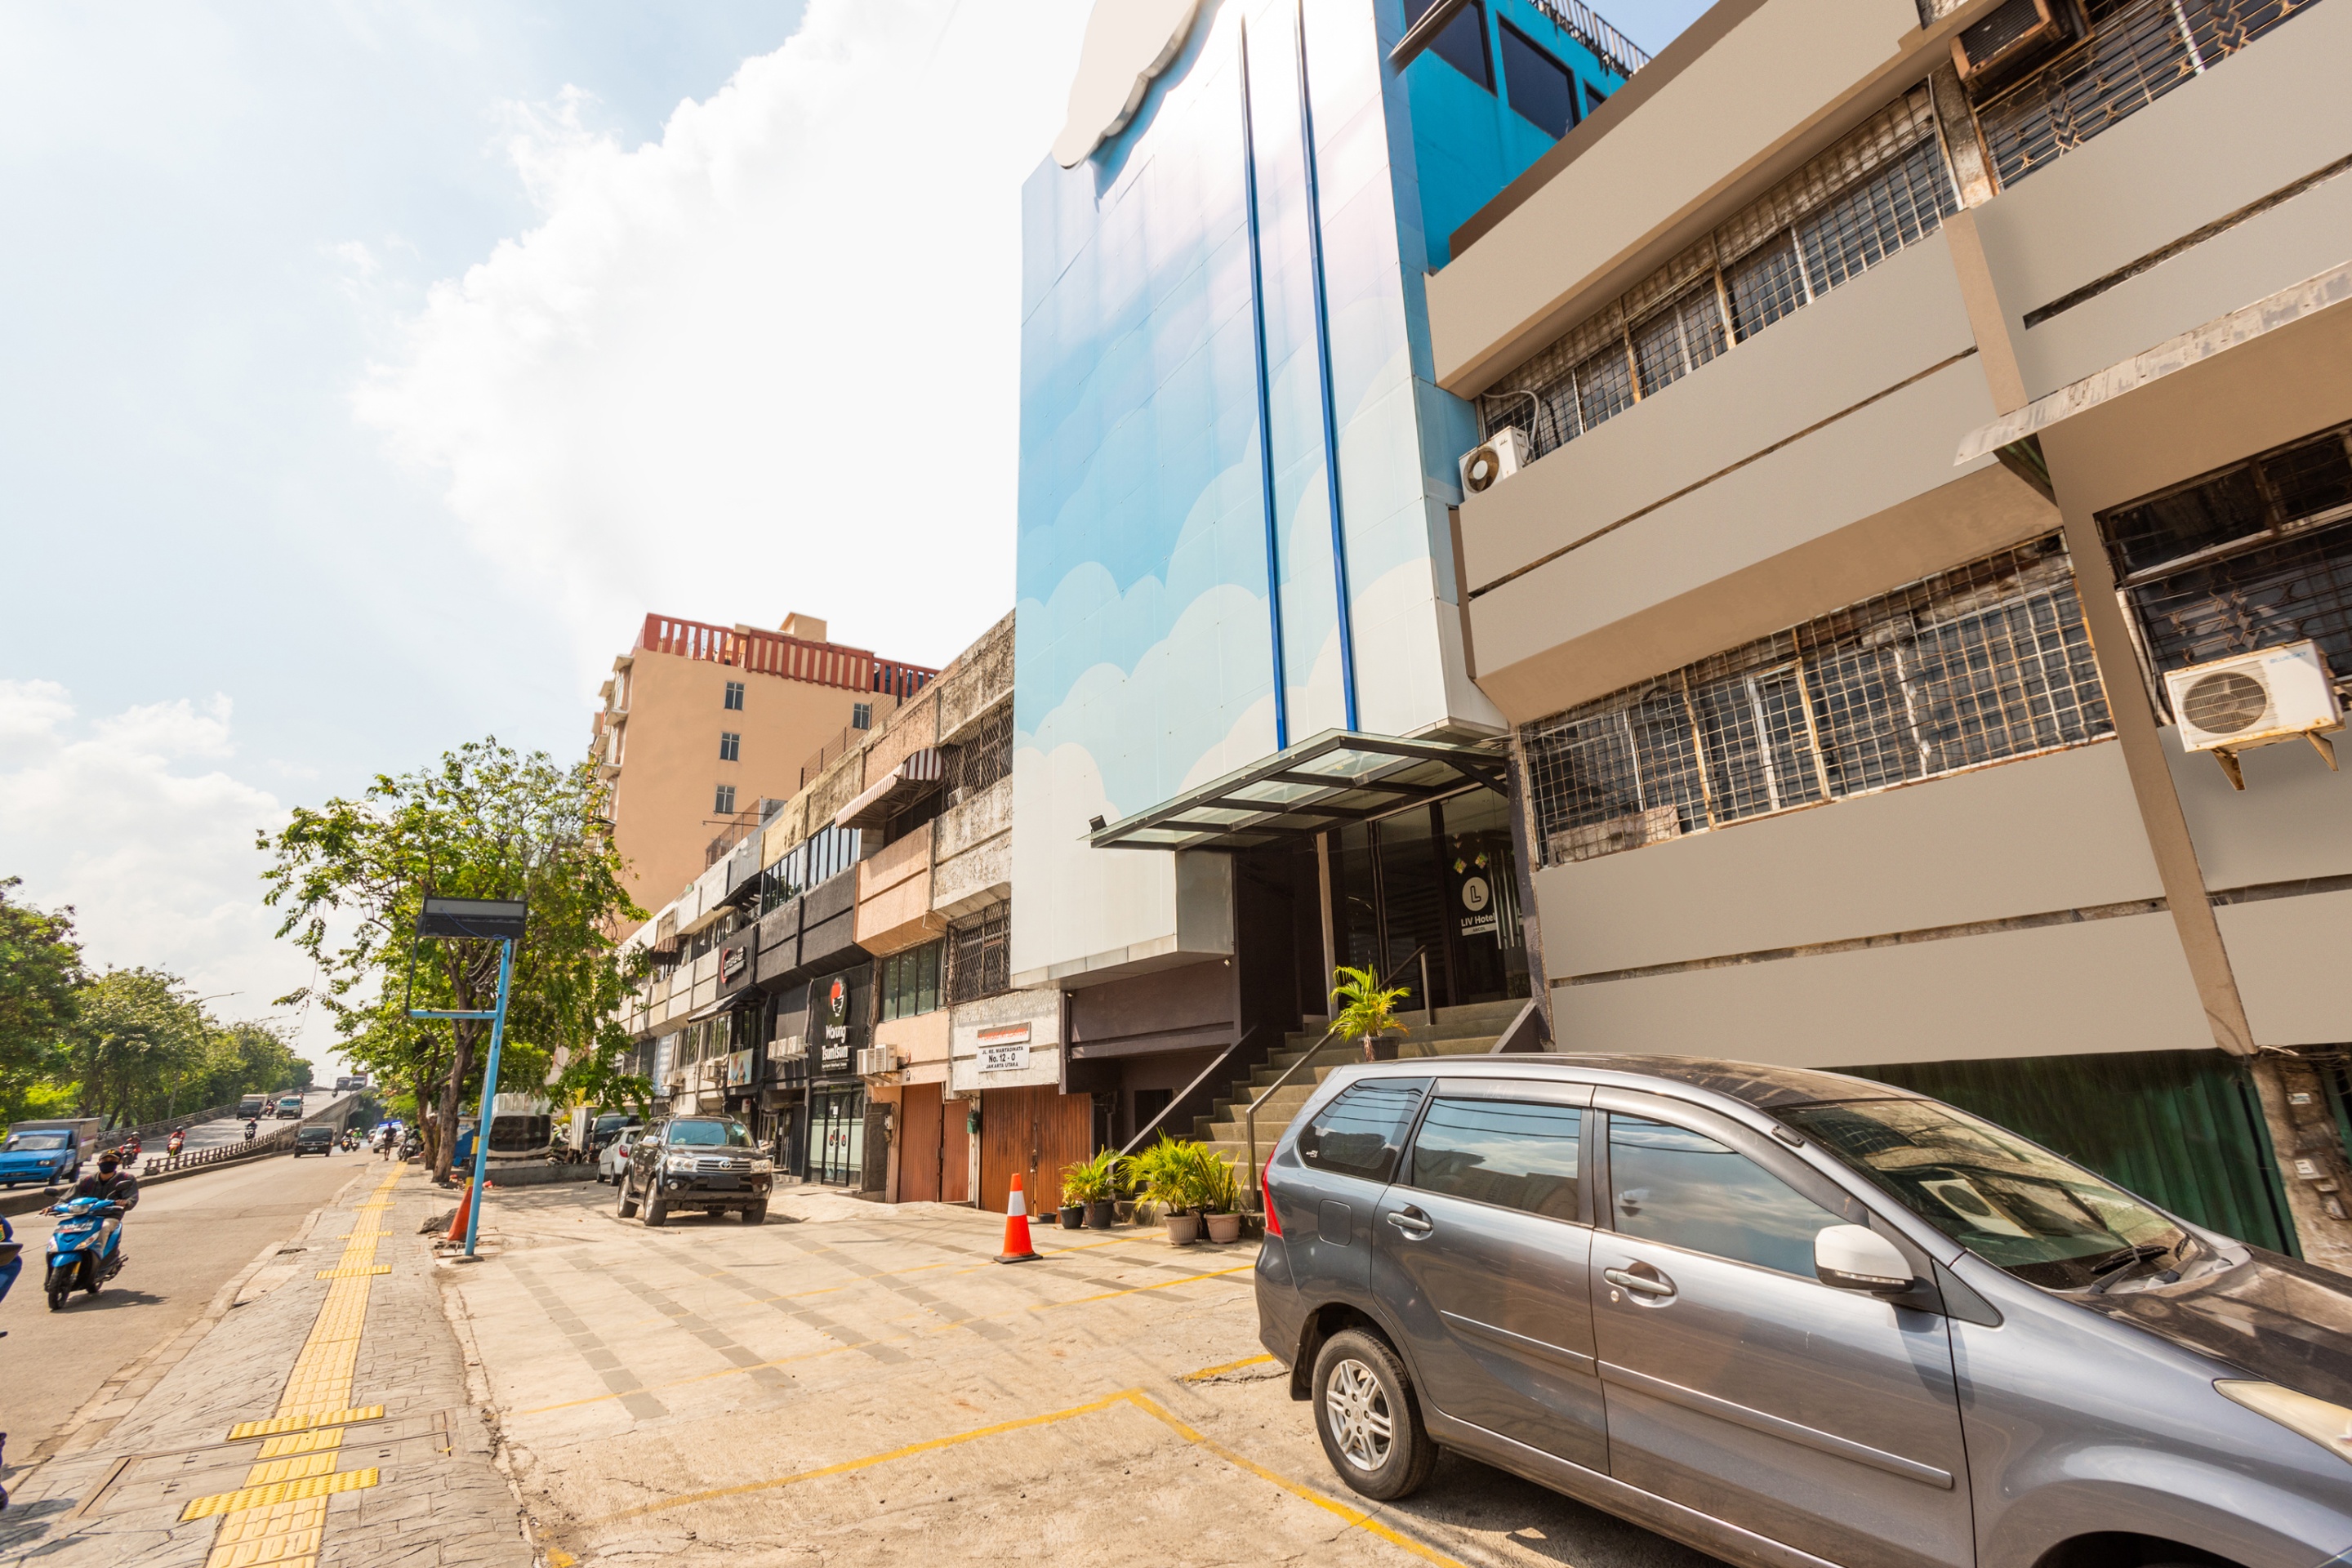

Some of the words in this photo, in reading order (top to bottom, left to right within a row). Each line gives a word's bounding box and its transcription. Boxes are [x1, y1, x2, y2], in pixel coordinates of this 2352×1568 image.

[1461, 917, 1473, 927] LIV
[1475, 912, 1496, 924] Hotel
[826, 1024, 846, 1044] Warung
[822, 1044, 849, 1061] TsumTsum
[988, 1055, 998, 1063] No.
[1000, 1054, 1006, 1062] 12
